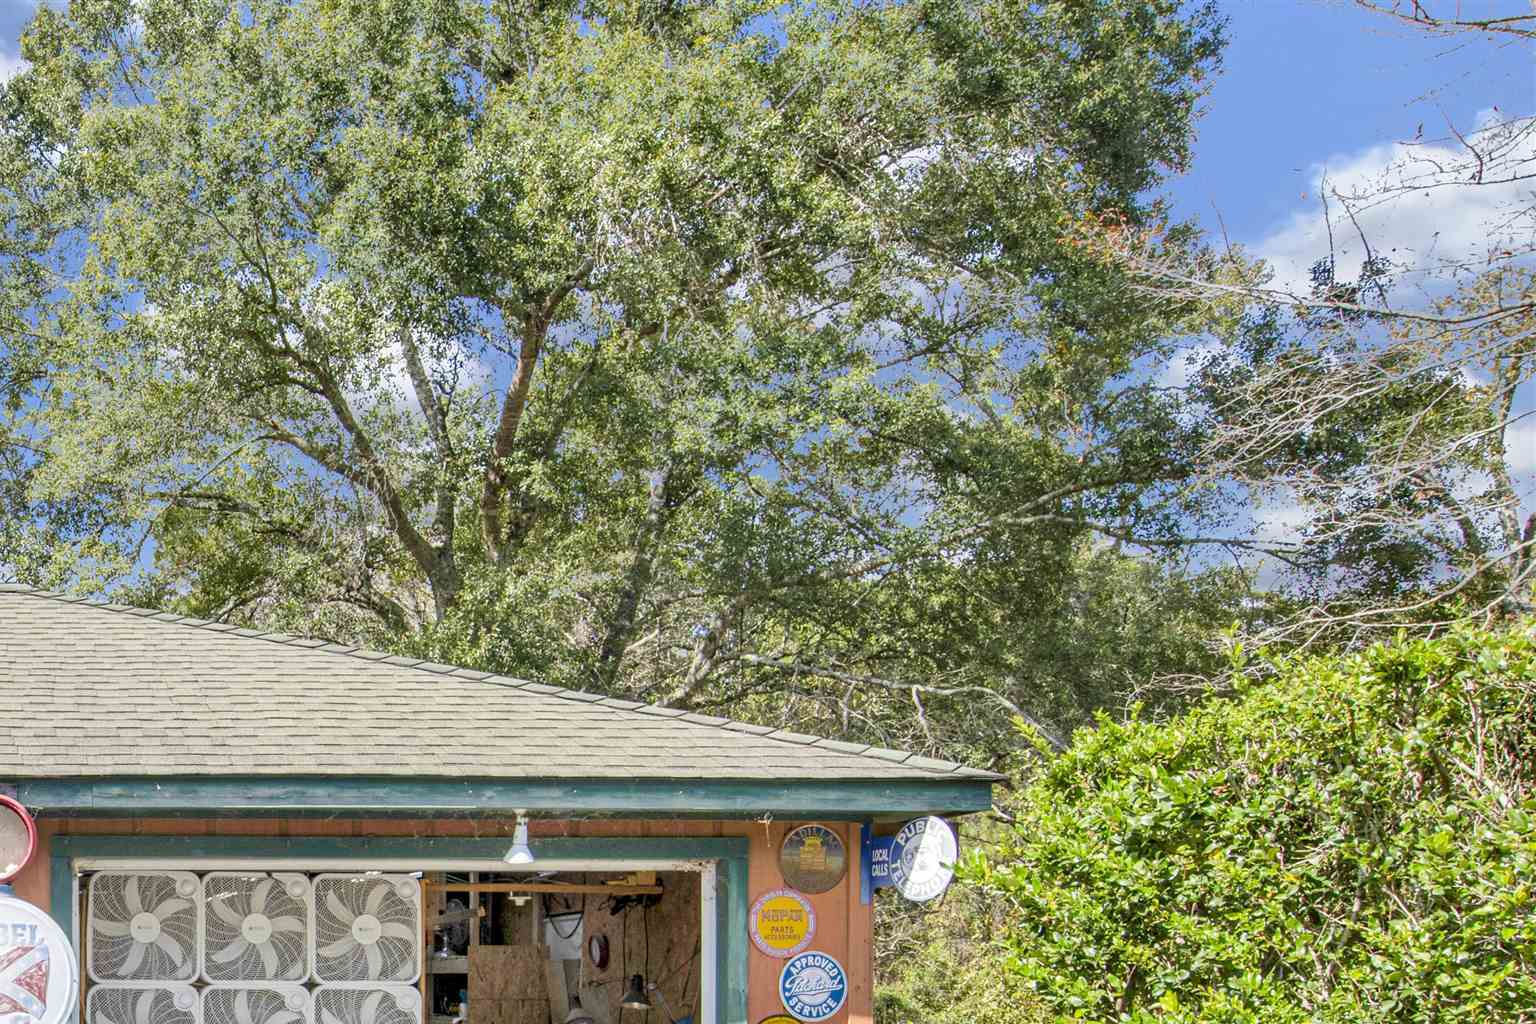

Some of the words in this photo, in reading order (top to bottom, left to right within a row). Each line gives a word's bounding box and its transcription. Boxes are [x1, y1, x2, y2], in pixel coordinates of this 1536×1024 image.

[872, 849, 889, 862] LOCAL
[872, 863, 889, 877] CALLS
[790, 955, 839, 977] APPROVED
[788, 997, 838, 1018] SERVICE
